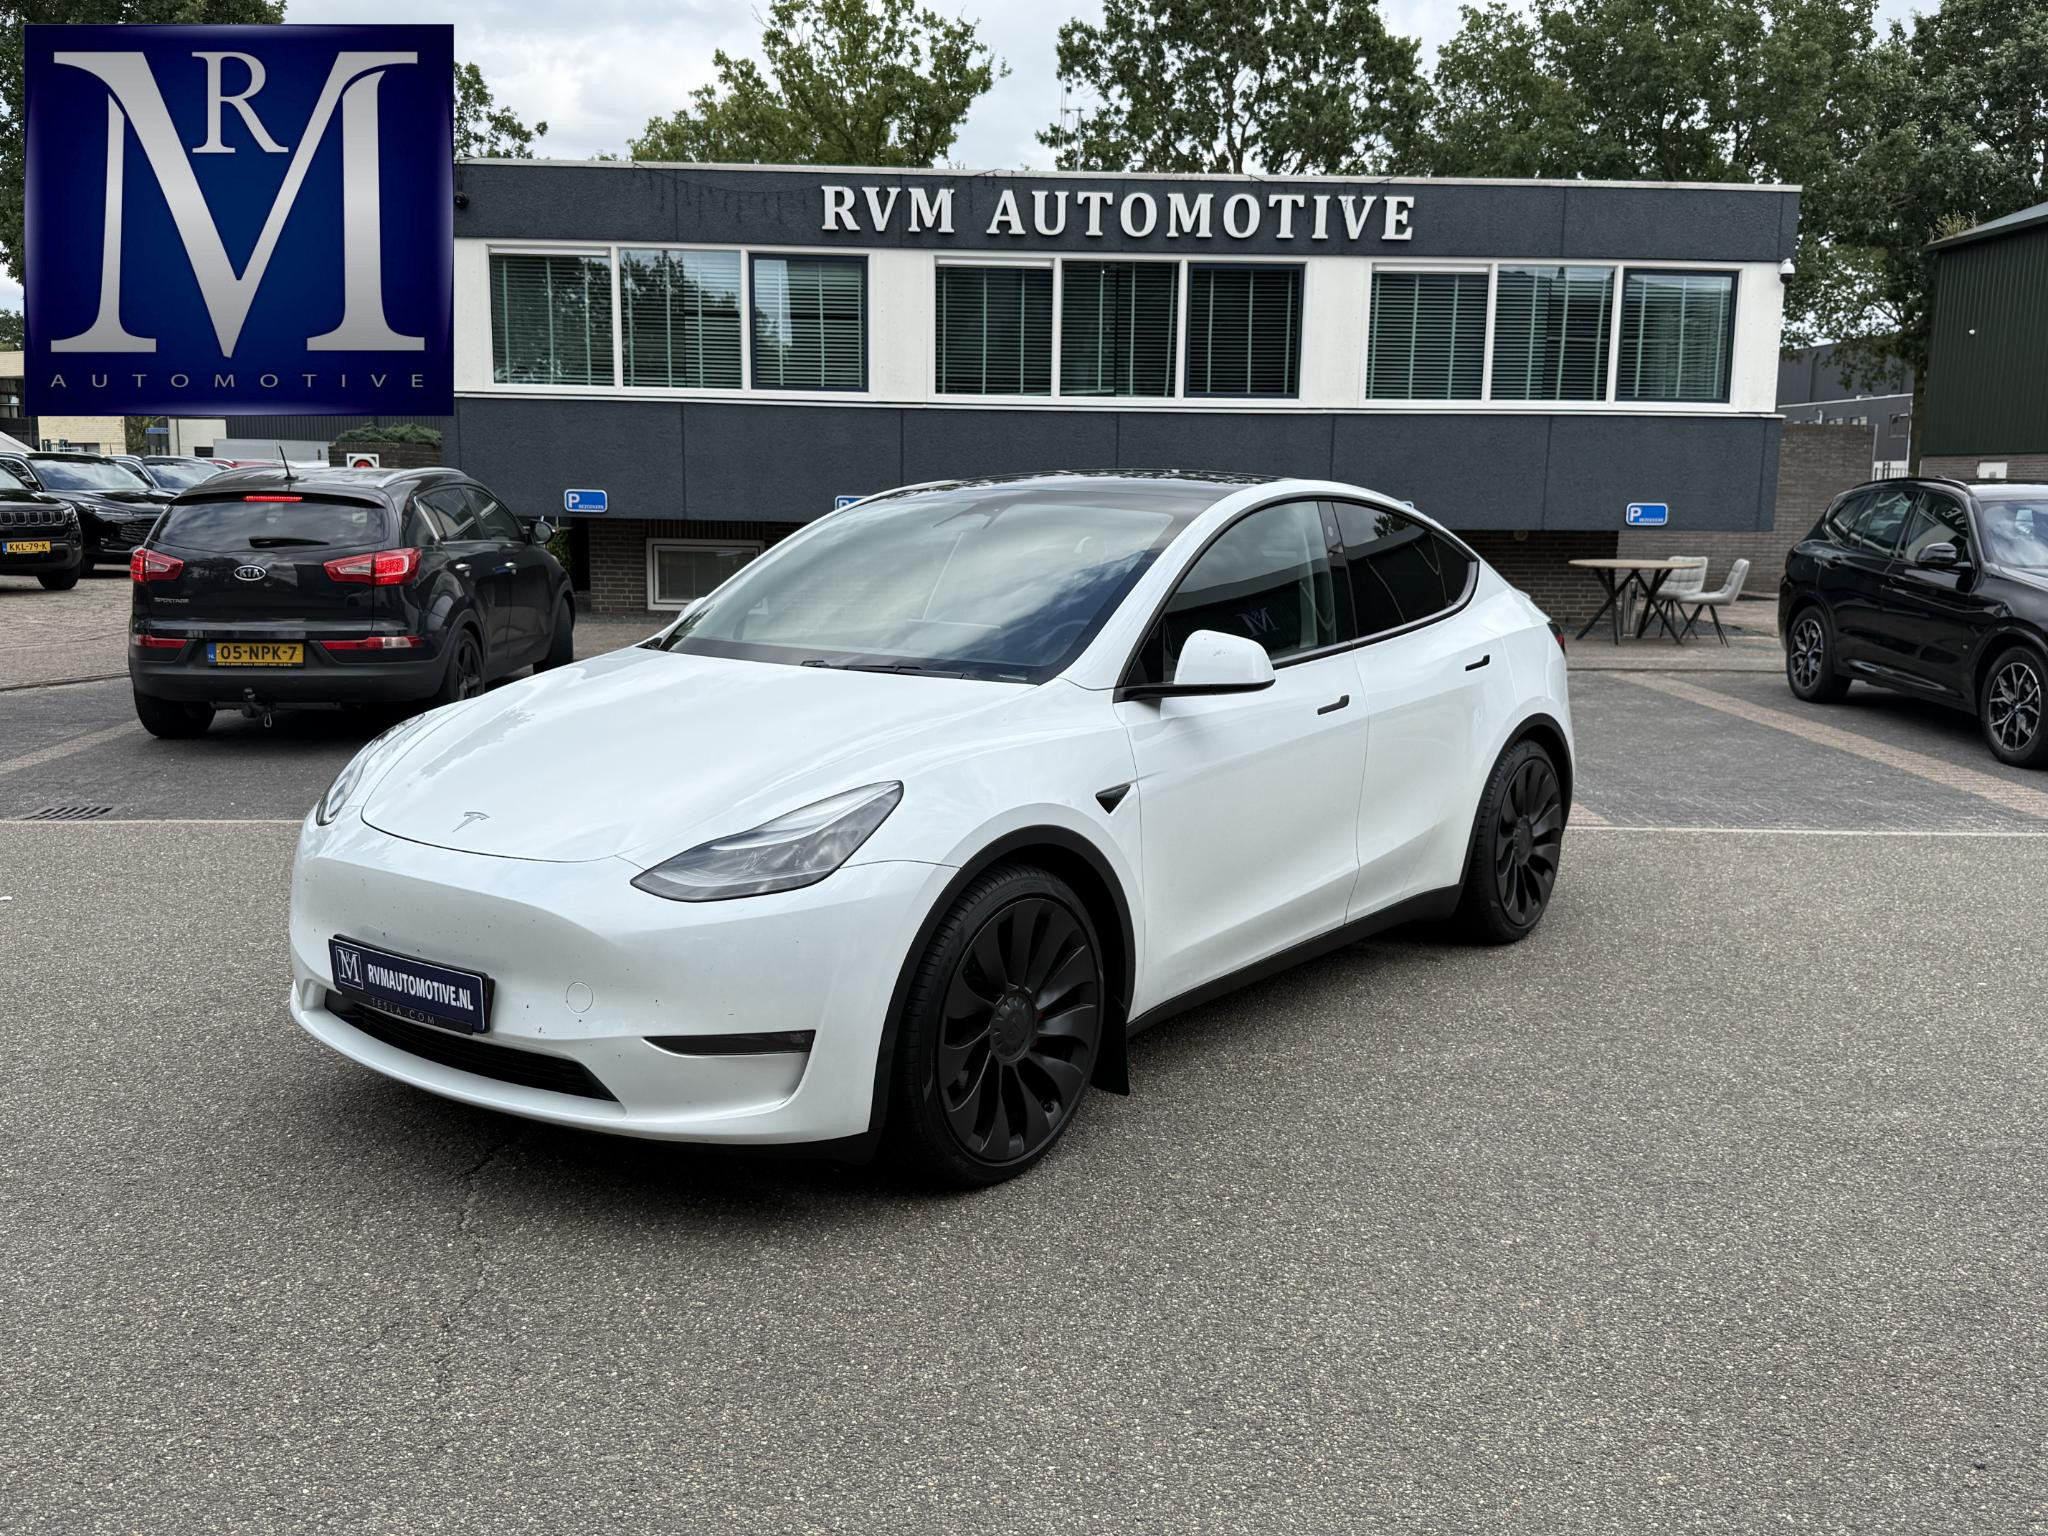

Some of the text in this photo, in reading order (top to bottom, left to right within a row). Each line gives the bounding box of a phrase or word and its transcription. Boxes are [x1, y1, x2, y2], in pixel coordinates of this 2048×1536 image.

[821, 186, 1415, 240] RVM AUTOMOTIVE
[568, 493, 580, 508] P
[1630, 507, 1641, 521] P
[10, 542, 47, 551] KKL-79-K
[240, 569, 260, 577] KIA
[221, 645, 297, 660] 05-NPK-7
[368, 964, 474, 1011] RVMAUTOMOTIVE.NL
[371, 998, 435, 1025] TESLA.COM
